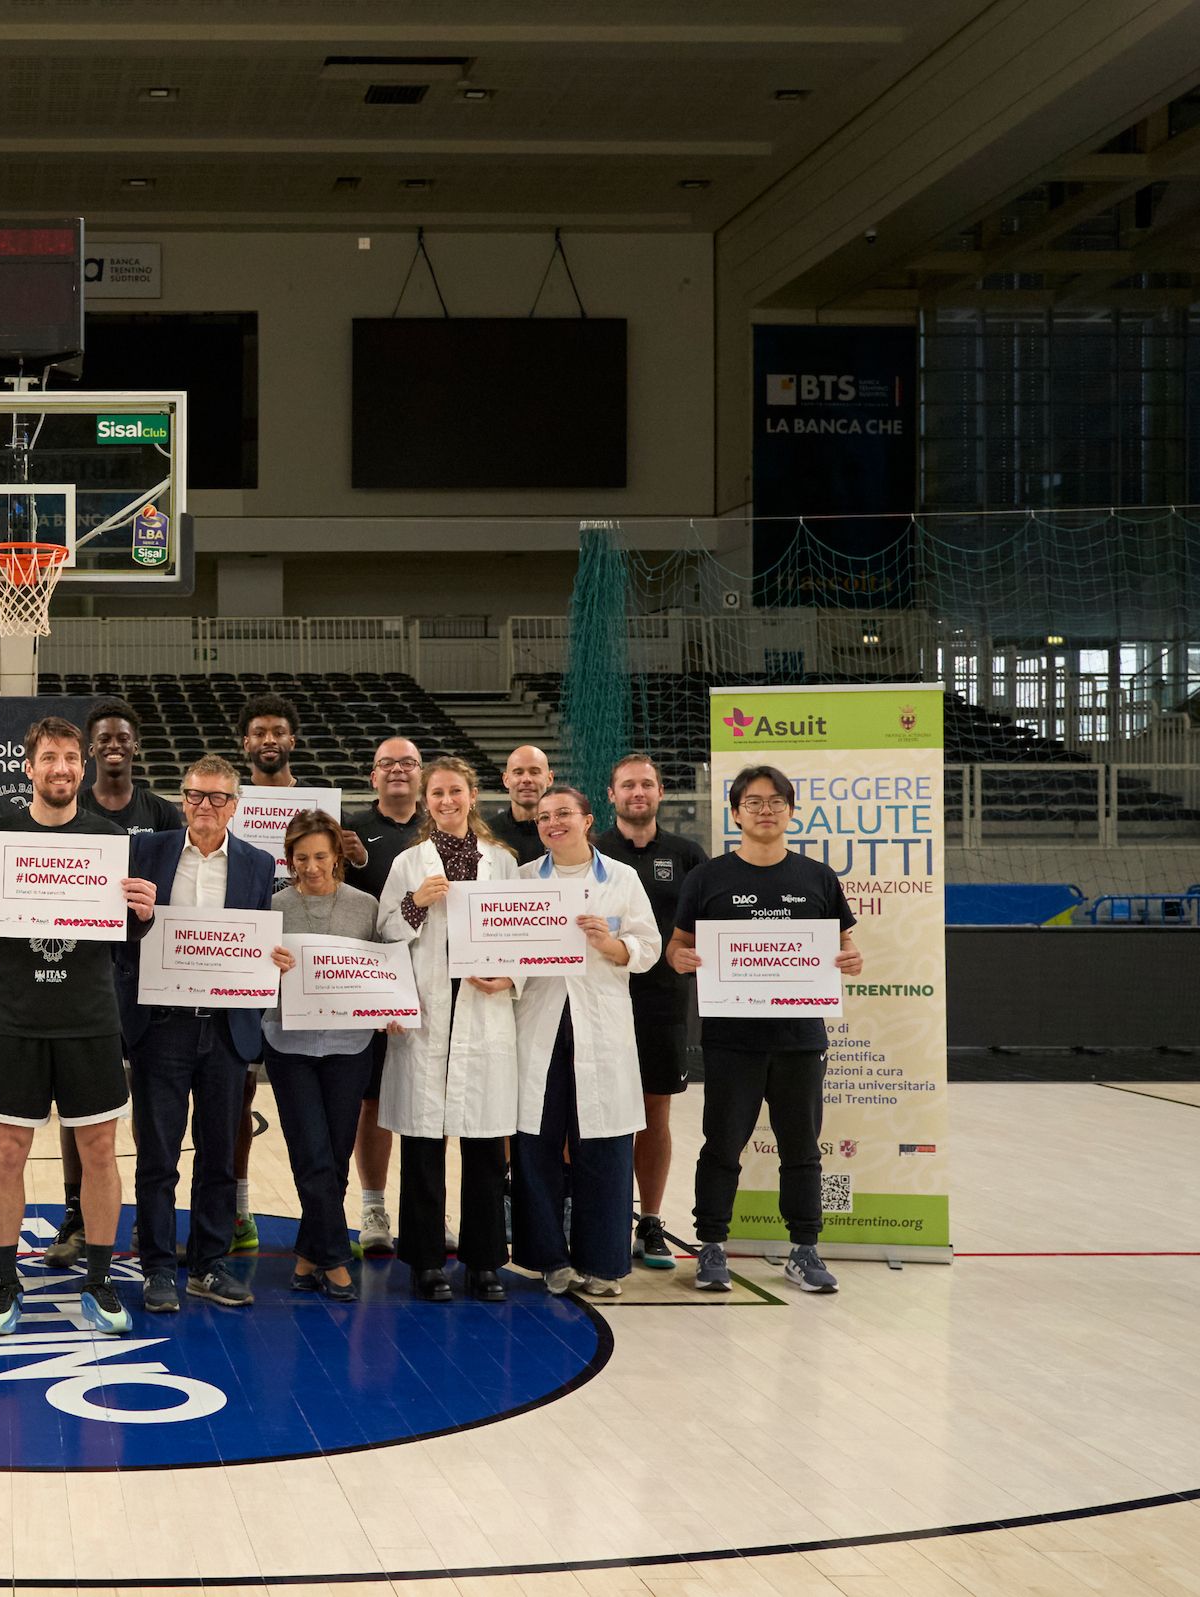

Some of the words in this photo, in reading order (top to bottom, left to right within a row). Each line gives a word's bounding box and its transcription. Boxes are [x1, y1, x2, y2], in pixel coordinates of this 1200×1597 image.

[800, 374, 856, 401] BTS
[98, 421, 142, 438] Sisal
[142, 427, 167, 438] Club
[766, 418, 790, 434] LA
[794, 419, 862, 435] BANCA
[865, 420, 903, 435] CHE
[138, 529, 165, 540] LBA
[138, 548, 162, 558] Sisal
[754, 715, 827, 737] Asuit
[723, 777, 932, 801] PTEGGERE
[243, 806, 300, 817] INFLUENZA
[243, 820, 288, 830] #IOMIVA
[15, 856, 90, 870] INFLUENZA?
[15, 873, 108, 886] #IOMIVACCINO
[838, 881, 933, 894] ORMAZIONE
[732, 894, 758, 904] DAO
[480, 901, 551, 912] INFLUENZA?
[482, 916, 568, 927] #IOMIVACCINO
[174, 930, 245, 943] INFLUENZA?
[174, 945, 262, 958] #IOMIVACCINO
[730, 943, 802, 952] INFLUENZA?
[313, 955, 379, 967] INFLUENZA?
[731, 957, 820, 967] #IOMIVACCINO
[46, 970, 68, 979] ITAS
[314, 969, 397, 981] #IOMIVACCINO
[845, 984, 934, 997] TRENTINO
[838, 1023, 849, 1033] di
[827, 1038, 871, 1048] azione
[827, 1066, 863, 1076] azioni
[866, 1068, 873, 1076] a
[876, 1068, 903, 1076] cura
[823, 1079, 855, 1090] itaria
[858, 1080, 936, 1091] universitaria
[823, 1094, 842, 1103] del
[845, 1094, 897, 1104] Trentino
